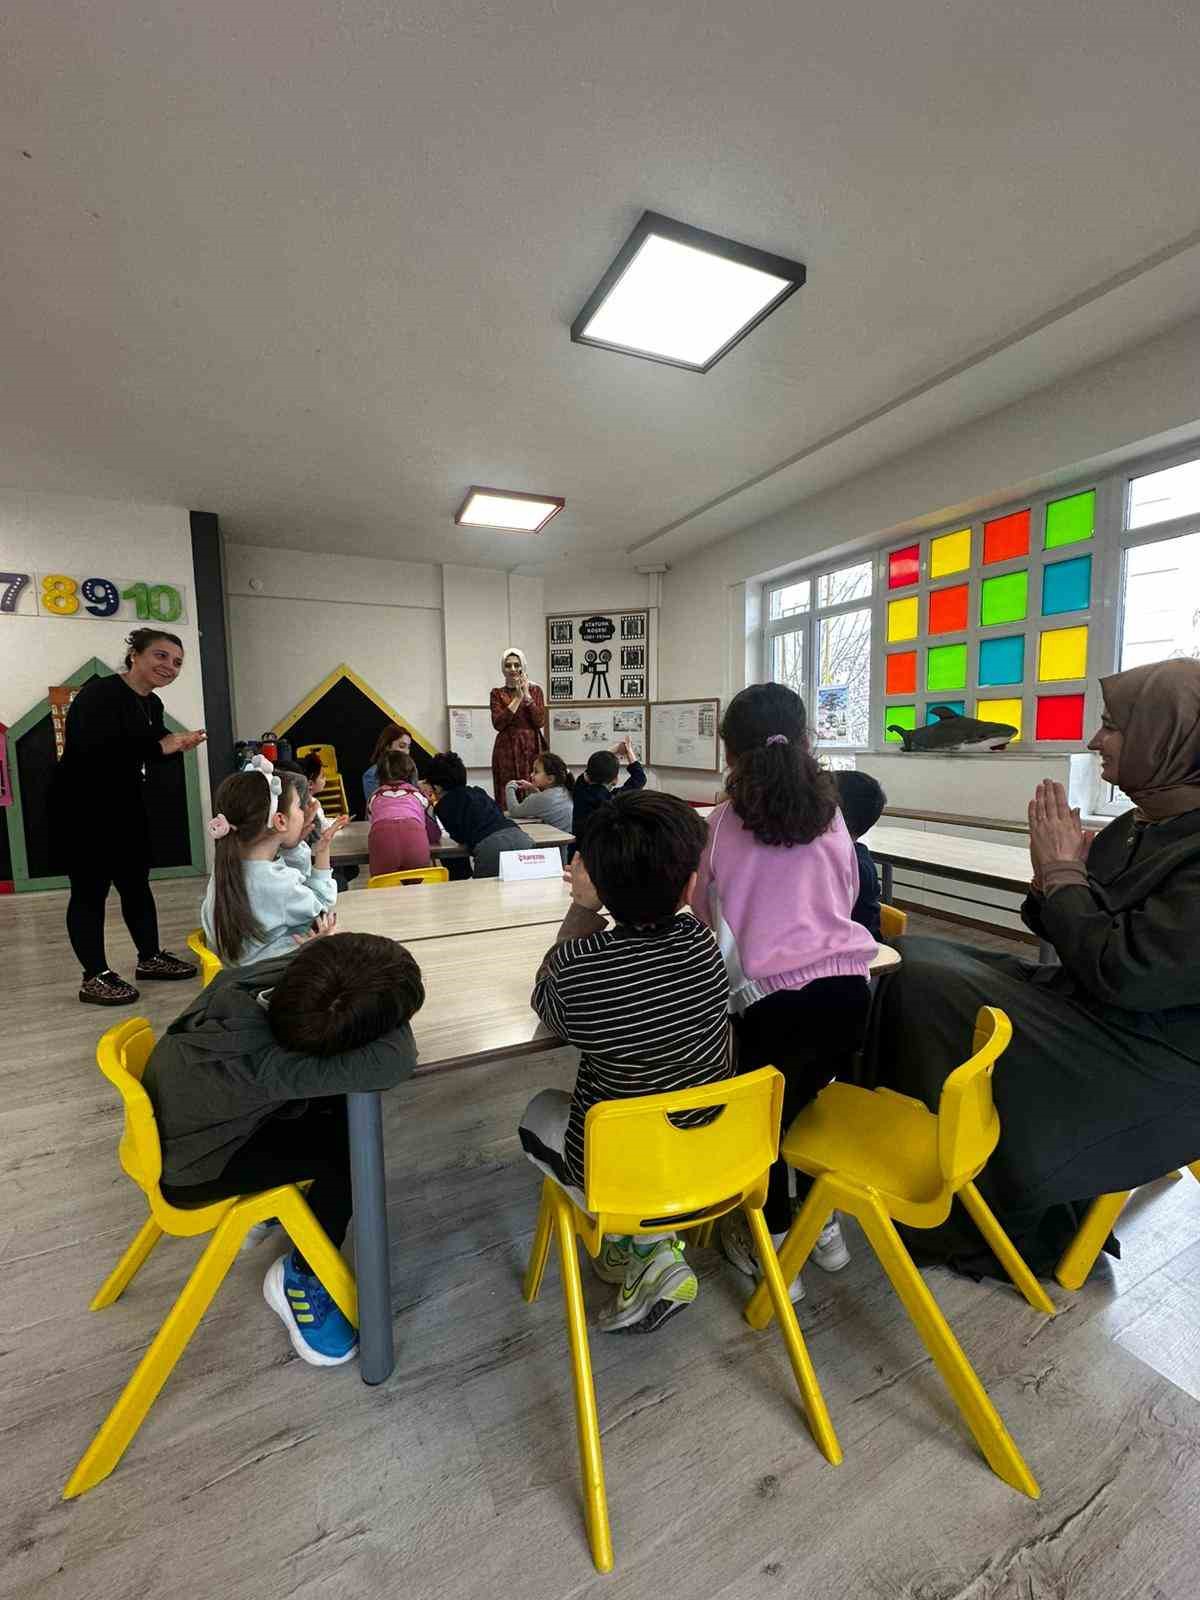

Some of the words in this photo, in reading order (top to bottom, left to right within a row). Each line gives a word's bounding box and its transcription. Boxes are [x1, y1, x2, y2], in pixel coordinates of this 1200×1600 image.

[0, 572, 30, 612] 7
[41, 574, 80, 615] 8
[81, 577, 120, 617] 9
[122, 582, 182, 622] 10
